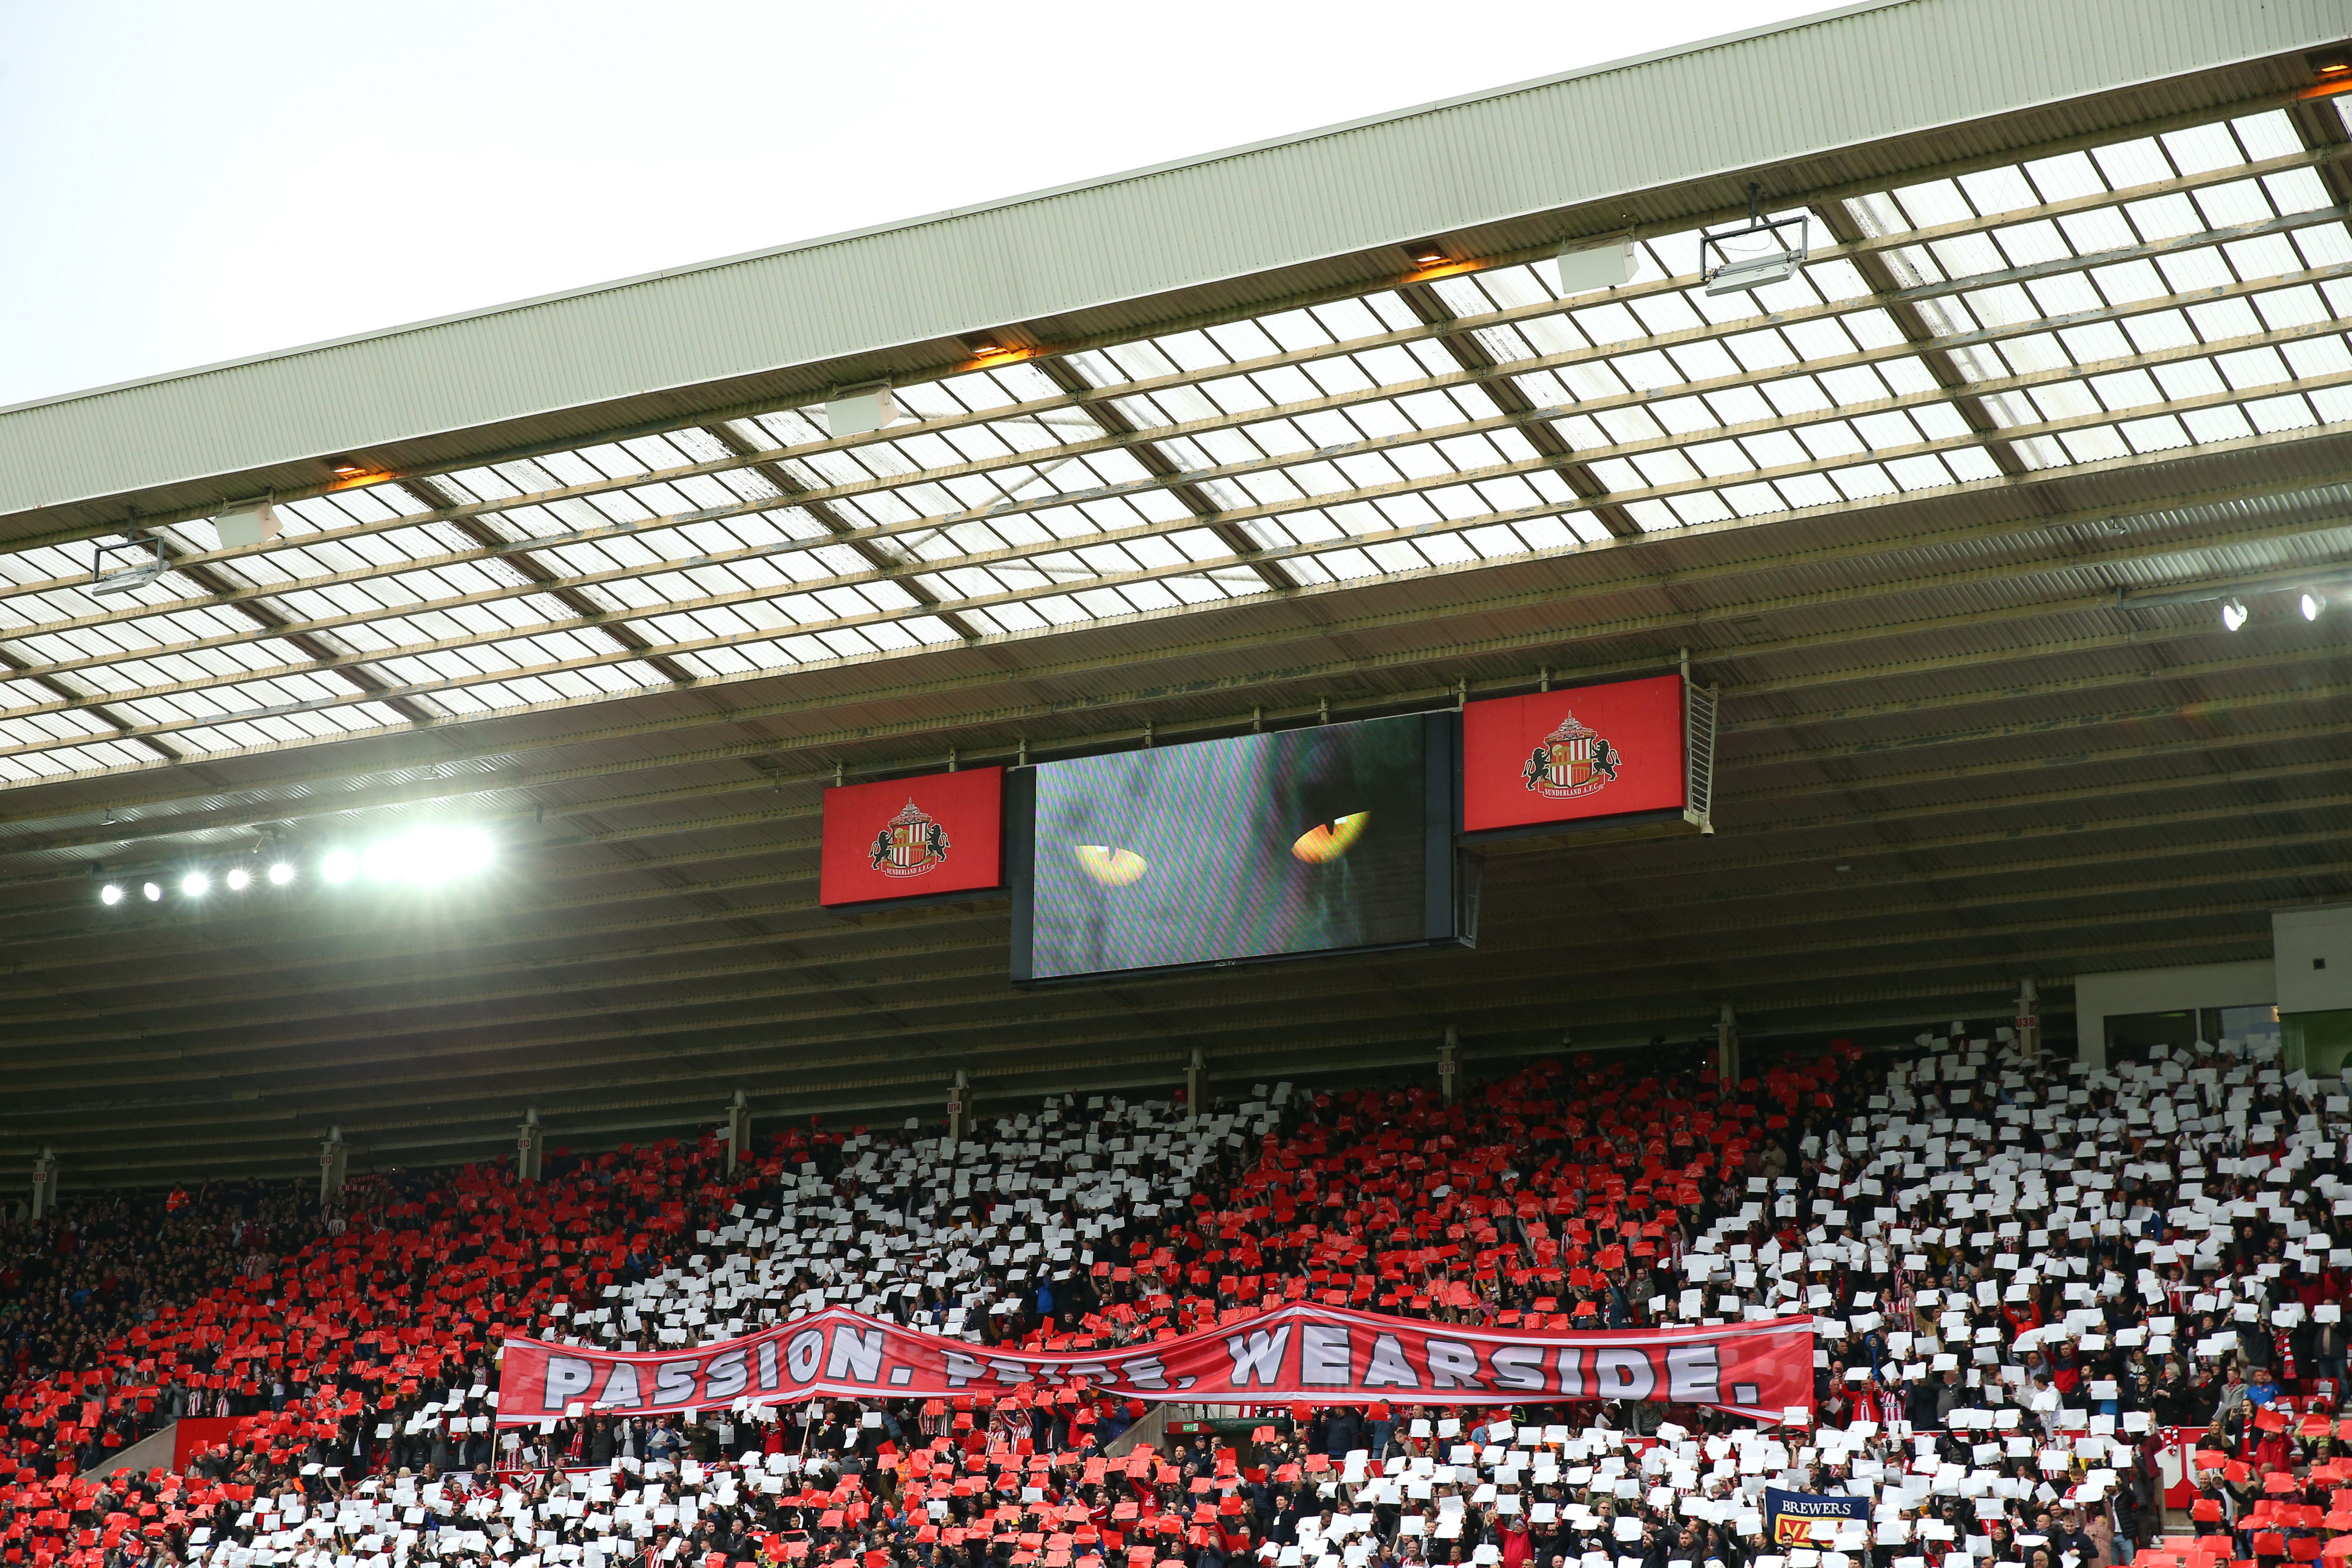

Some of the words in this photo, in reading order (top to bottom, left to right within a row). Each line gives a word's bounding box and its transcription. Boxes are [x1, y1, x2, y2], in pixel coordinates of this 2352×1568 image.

[1544, 788, 1581, 796] SUNDERLAND
[1583, 783, 1599, 793] A.F.C.
[918, 863, 931, 872] A.F.C.
[2016, 1017, 2035, 1028] U38
[1439, 1062, 1454, 1073] U37
[948, 1103, 960, 1112] U14
[519, 1139, 530, 1148] U13
[321, 1156, 332, 1165] U13
[34, 1173, 46, 1181] U12
[543, 1324, 914, 1410] PASSION.
[1225, 1322, 1760, 1405] WEARSIDE.
[1781, 1500, 1852, 1515] BREWERS
